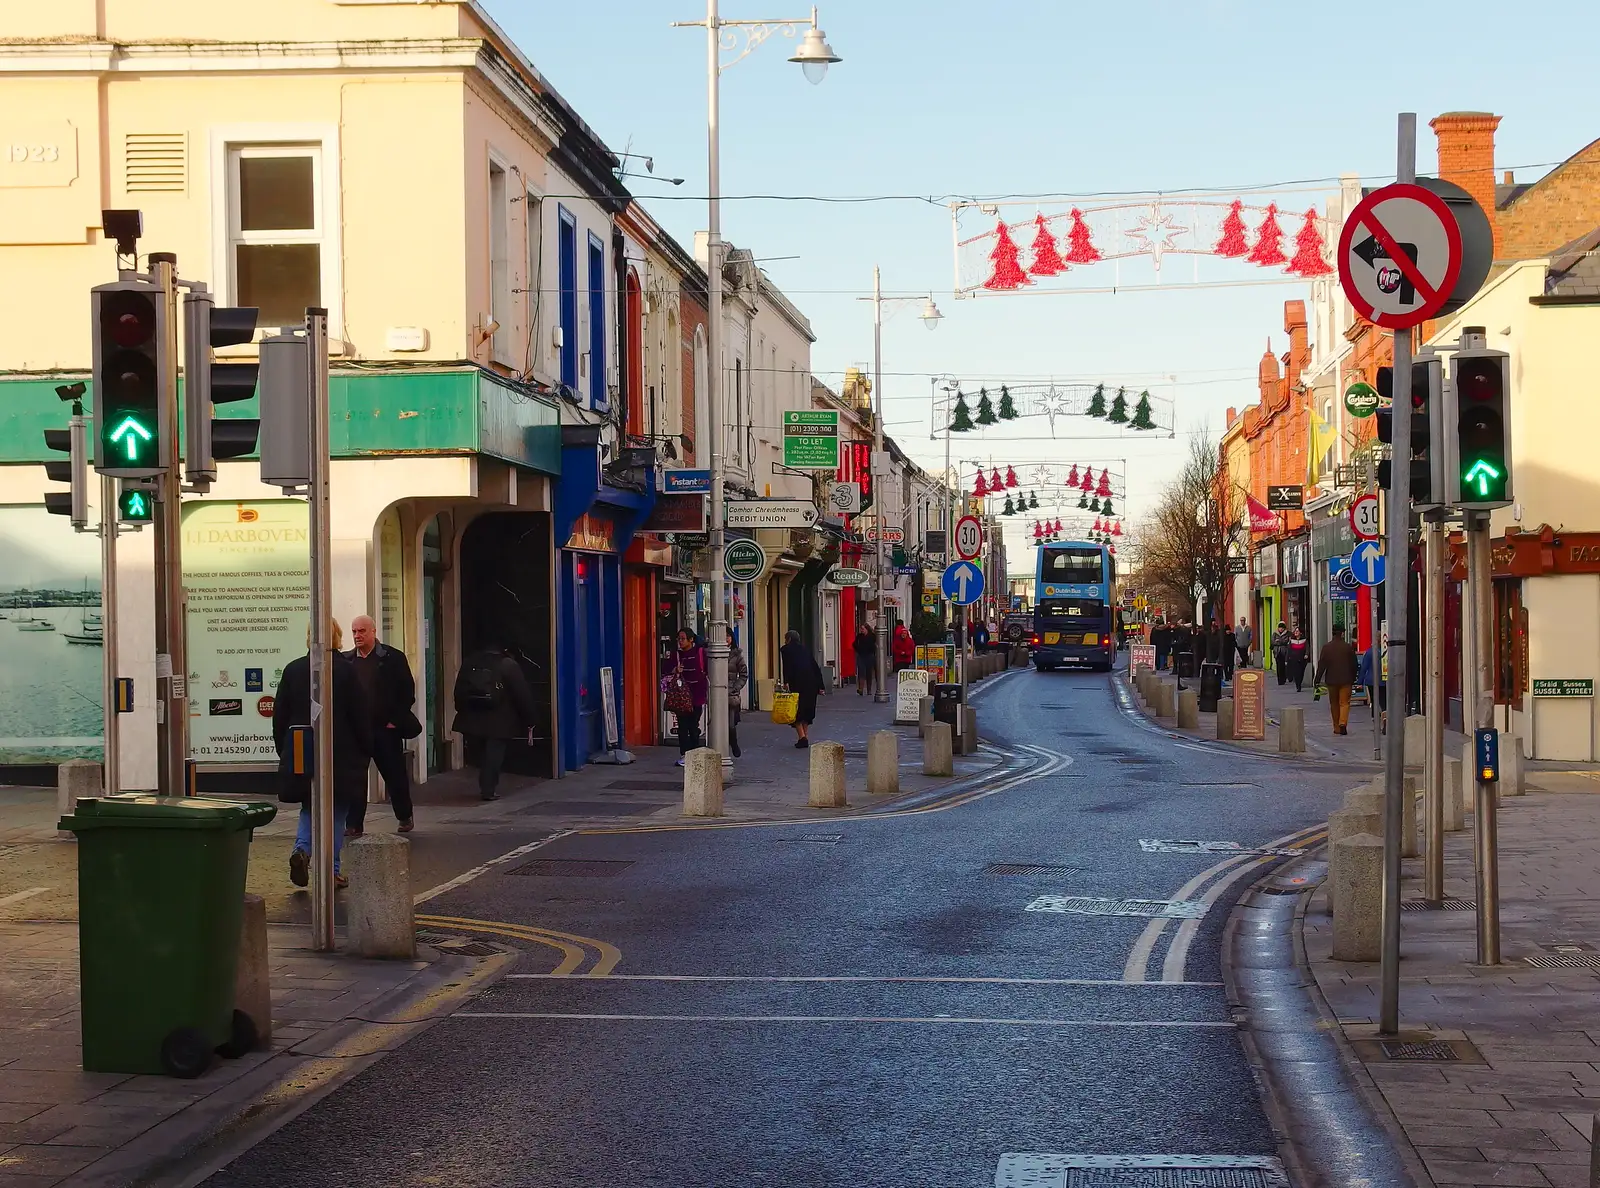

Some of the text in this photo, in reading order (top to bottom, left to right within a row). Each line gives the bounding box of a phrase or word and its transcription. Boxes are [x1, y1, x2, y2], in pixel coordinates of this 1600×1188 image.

[6, 145, 58, 162] 1923
[1347, 394, 1376, 406] Carlsberg
[836, 485, 853, 507] 3
[1361, 506, 1377, 524] 30
[962, 527, 976, 545] 30
[899, 671, 927, 684] HICK'S
[211, 701, 240, 710] Alberto
